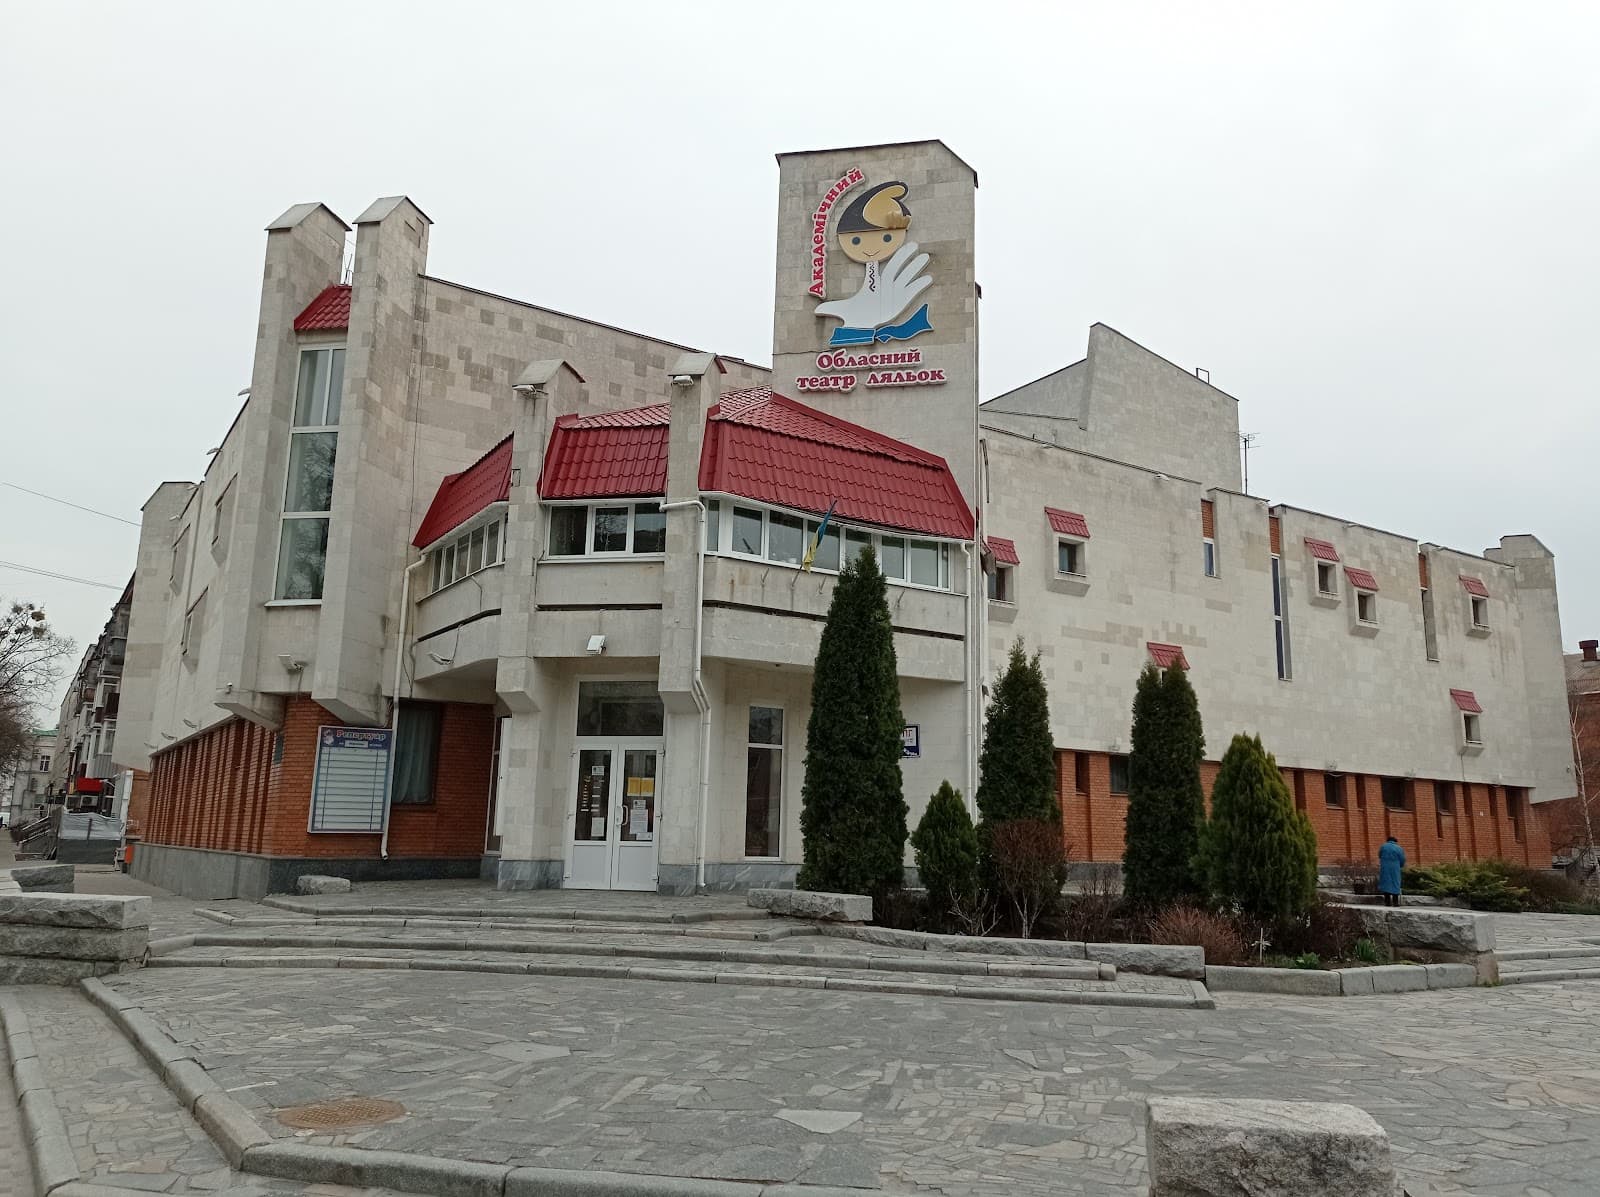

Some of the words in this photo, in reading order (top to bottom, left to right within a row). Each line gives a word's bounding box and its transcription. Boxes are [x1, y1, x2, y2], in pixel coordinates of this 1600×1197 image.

[808, 168, 865, 297] Академічний
[816, 348, 921, 370] Обласний
[796, 374, 856, 390] театр
[866, 369, 945, 385] ляльок
